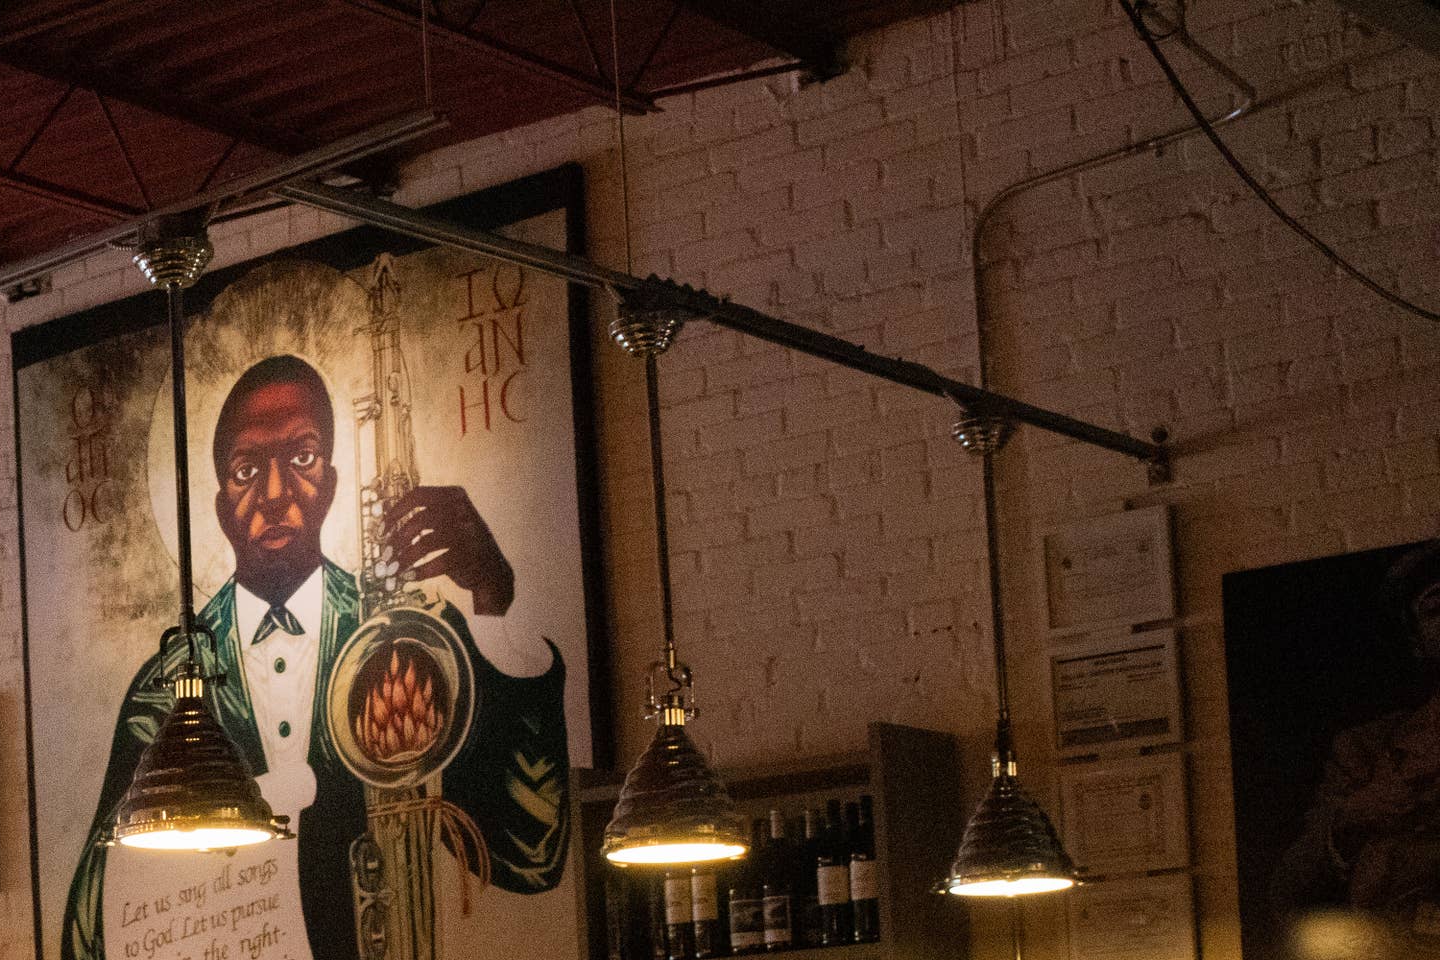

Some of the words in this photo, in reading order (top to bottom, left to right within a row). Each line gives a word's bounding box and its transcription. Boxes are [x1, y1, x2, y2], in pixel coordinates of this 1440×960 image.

[121, 902, 148, 928] Let
[154, 895, 171, 914] us
[213, 864, 232, 893] all
[237, 858, 278, 885] songs
[124, 940, 139, 958] to
[181, 915, 208, 940] Let
[210, 910, 227, 929] us
[231, 893, 280, 932] pursue
